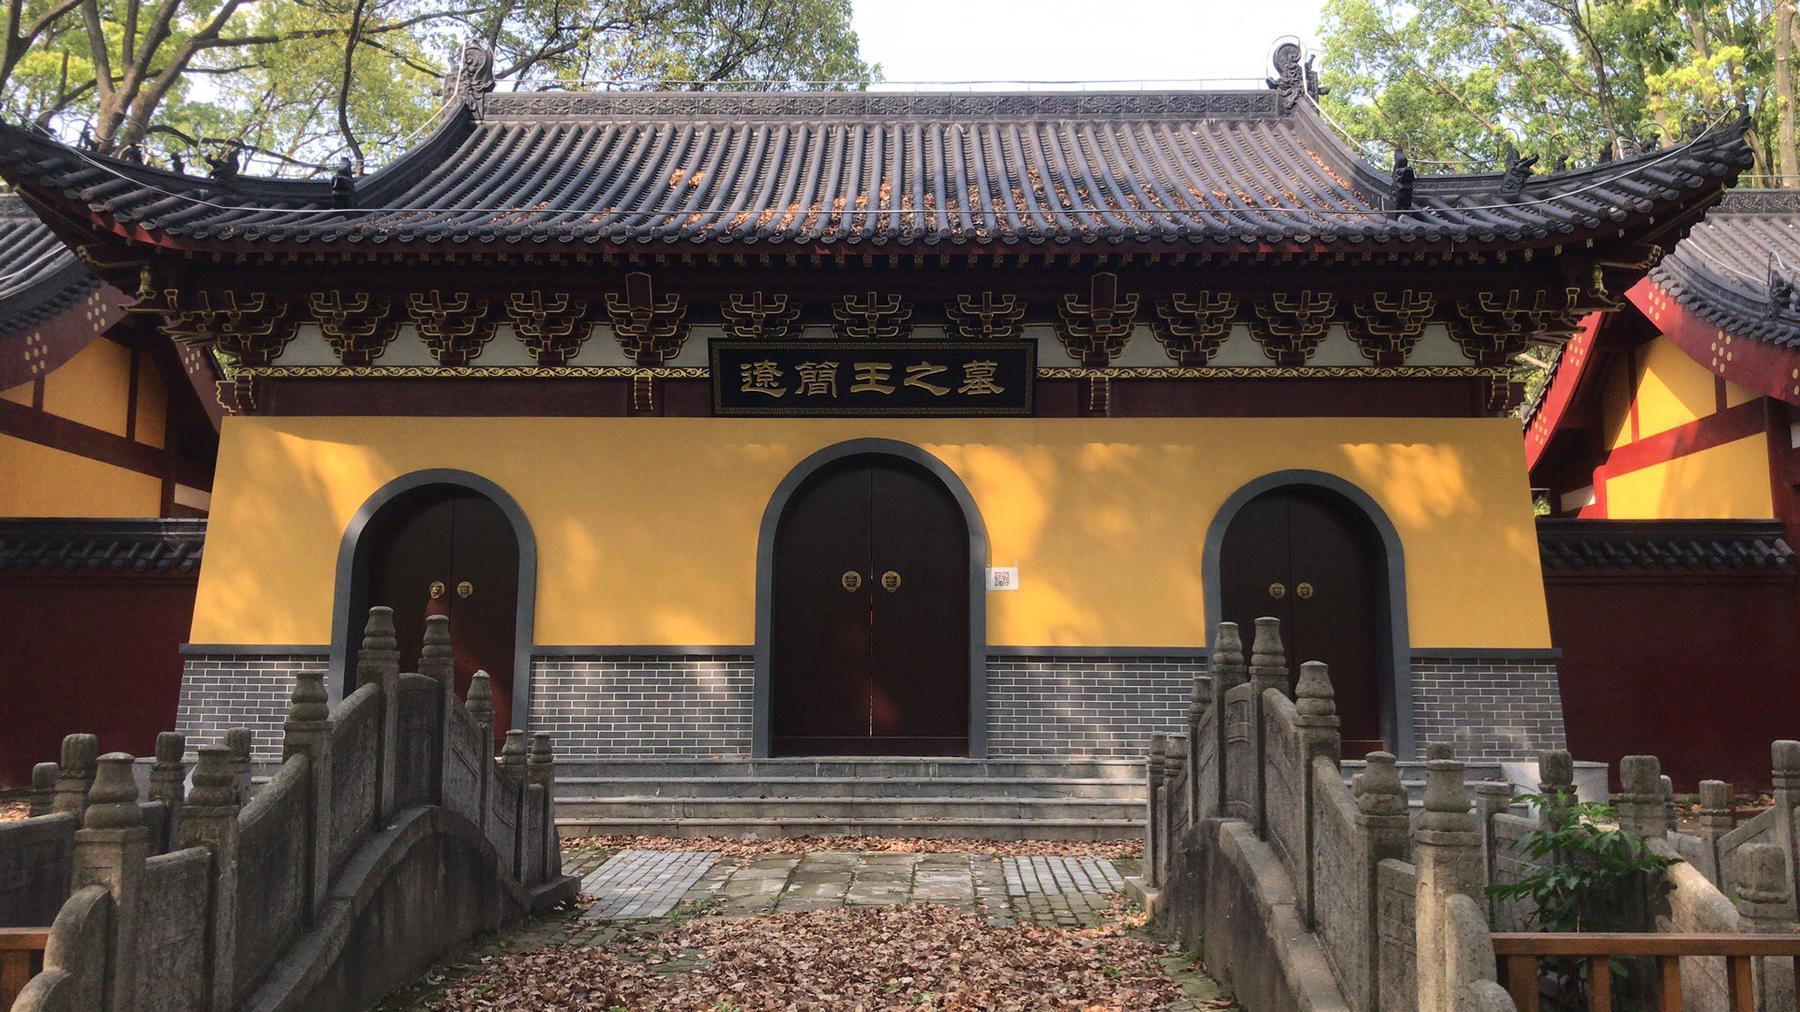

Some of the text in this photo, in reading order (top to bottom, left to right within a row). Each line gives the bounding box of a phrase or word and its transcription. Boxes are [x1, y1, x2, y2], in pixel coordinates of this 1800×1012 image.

[739, 359, 1005, 398] 遼簡王之墓
